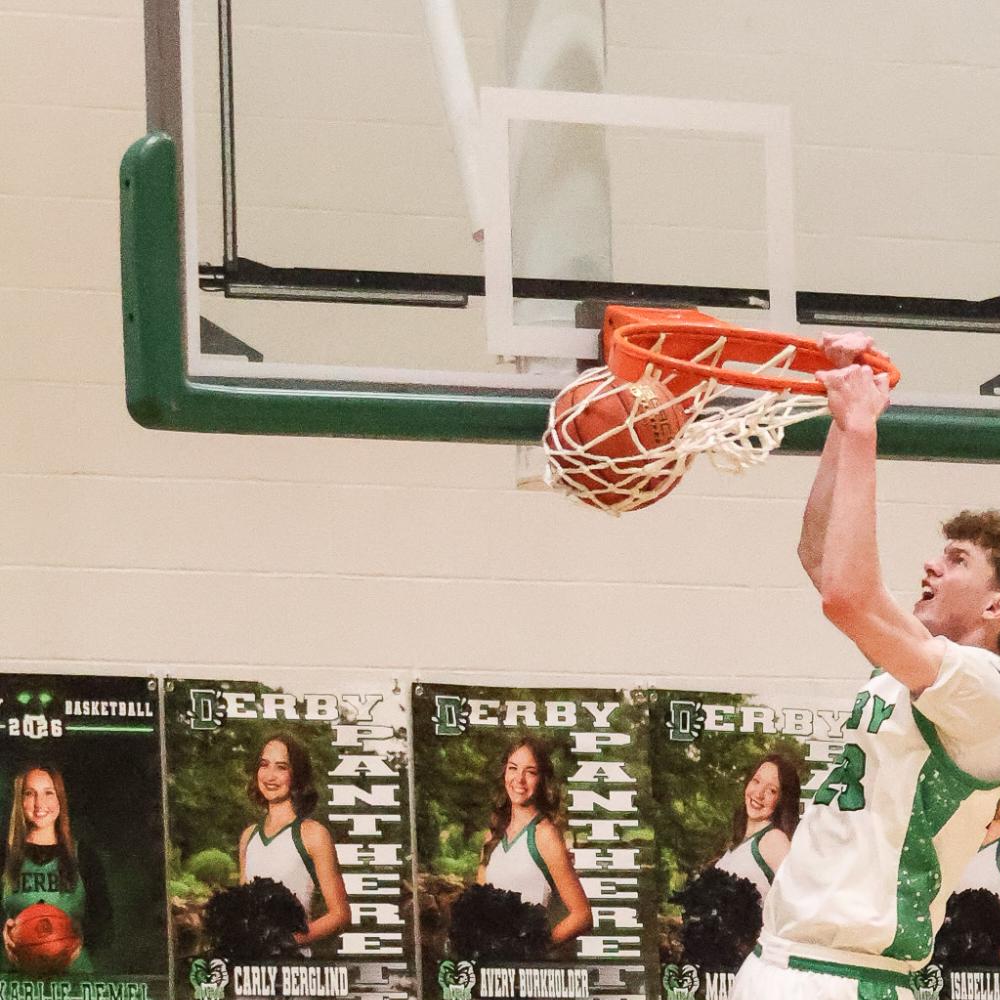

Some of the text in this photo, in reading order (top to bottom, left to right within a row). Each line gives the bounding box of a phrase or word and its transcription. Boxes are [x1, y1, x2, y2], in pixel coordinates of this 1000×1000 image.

[65, 700, 153, 717] BASKETBALL
[187, 689, 384, 730] DERBY
[431, 695, 620, 736] DERBY
[666, 700, 852, 741] DERBY
[233, 966, 349, 997] CARLY BERGLIND
[480, 968, 516, 998] AVERY
[951, 972, 1000, 1000] ISABELLA
